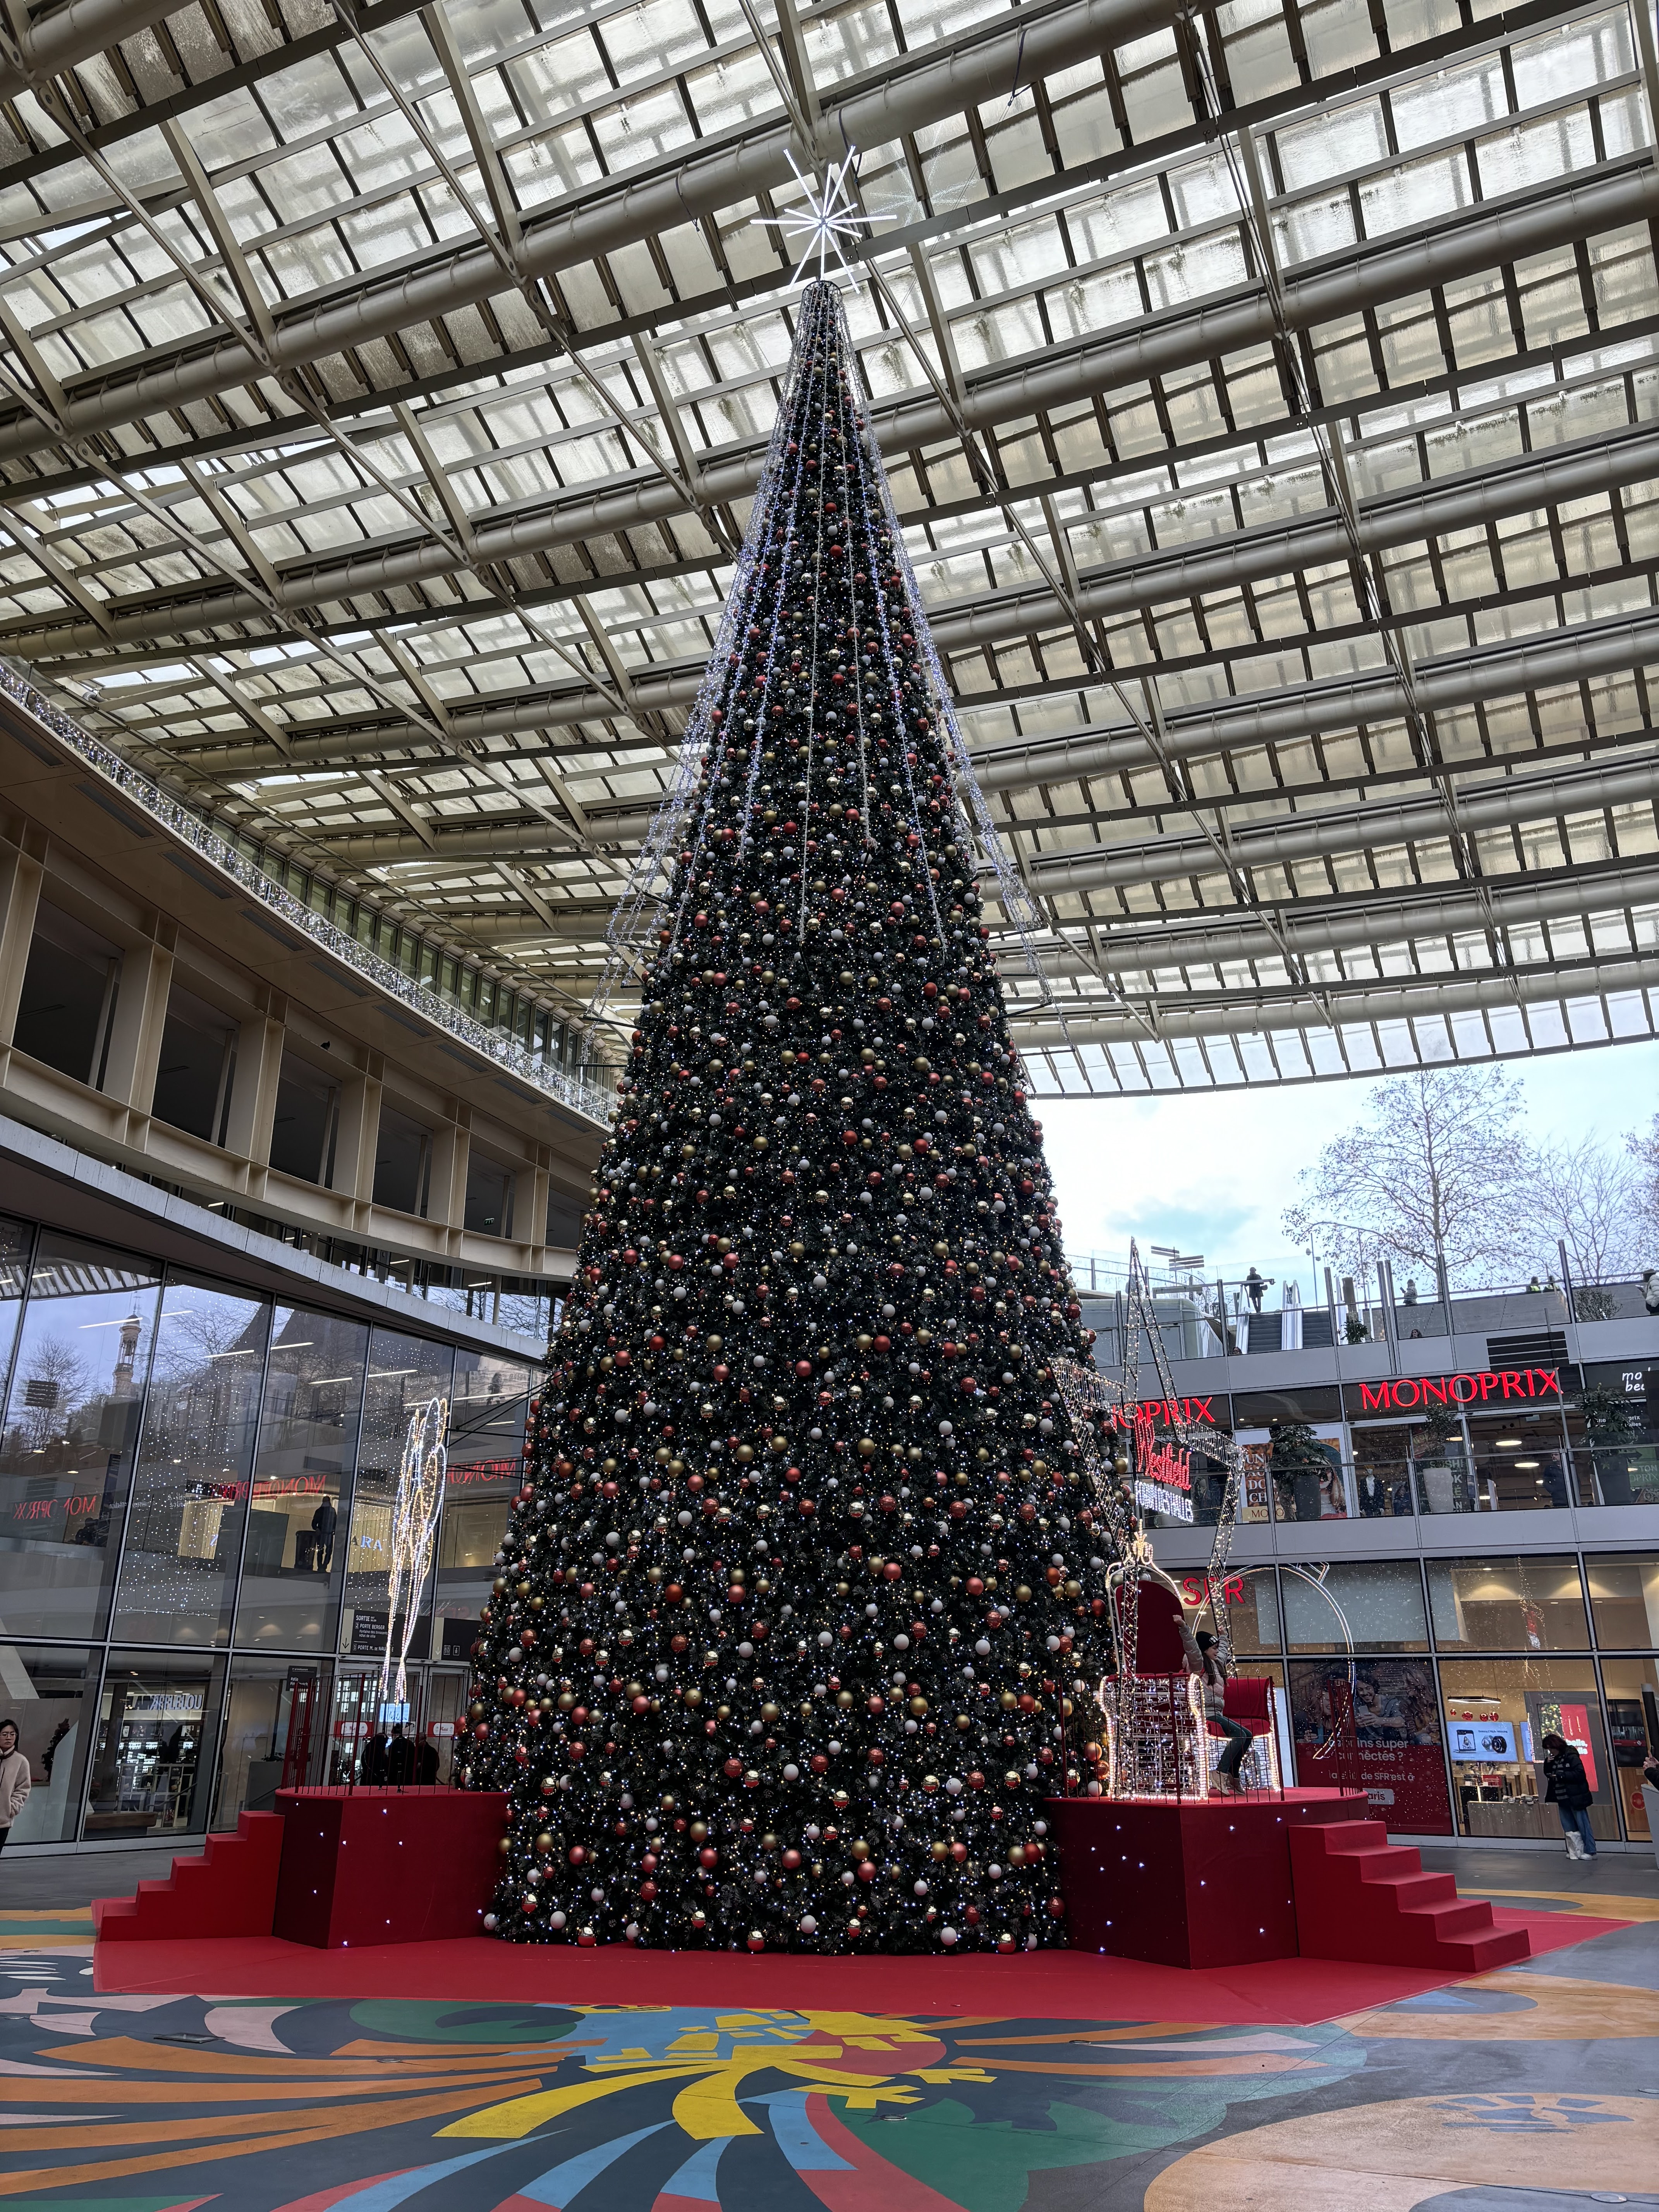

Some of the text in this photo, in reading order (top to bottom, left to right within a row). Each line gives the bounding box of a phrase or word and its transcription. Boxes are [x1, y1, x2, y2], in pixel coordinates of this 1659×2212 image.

[1359, 1367, 1564, 1410] MONOPRIX
[1112, 1397, 1216, 1430] OPRIX
[1132, 1413, 1192, 1491] Westfield
[350, 1535, 382, 1551] ARA
[150, 1695, 203, 1711] AFFLELOU
[1376, 1740, 1408, 1751] super
[1368, 1791, 1385, 1800] aris
